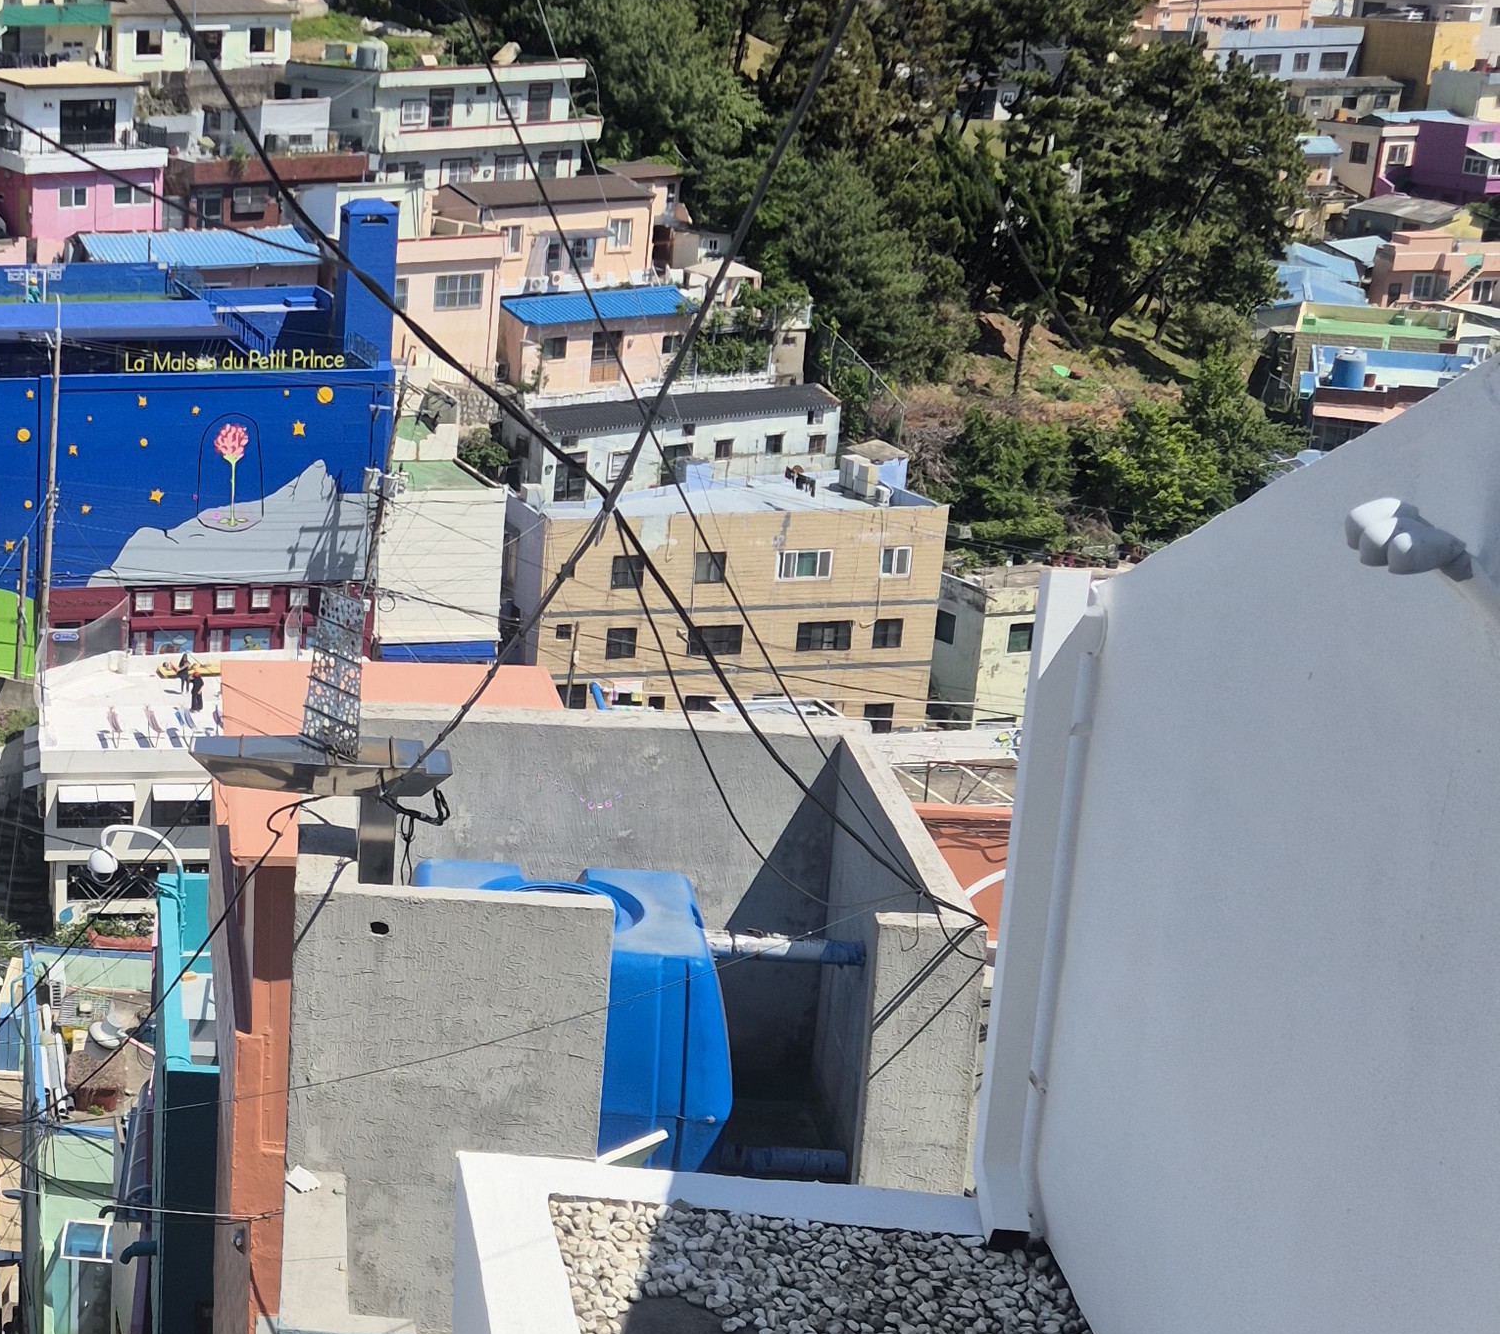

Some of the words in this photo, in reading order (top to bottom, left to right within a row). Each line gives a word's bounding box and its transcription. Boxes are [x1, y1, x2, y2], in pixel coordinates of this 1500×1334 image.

[125, 351, 145, 372] La
[222, 350, 244, 371] du
[249, 348, 288, 370] Petit
[292, 348, 345, 369] Prince
